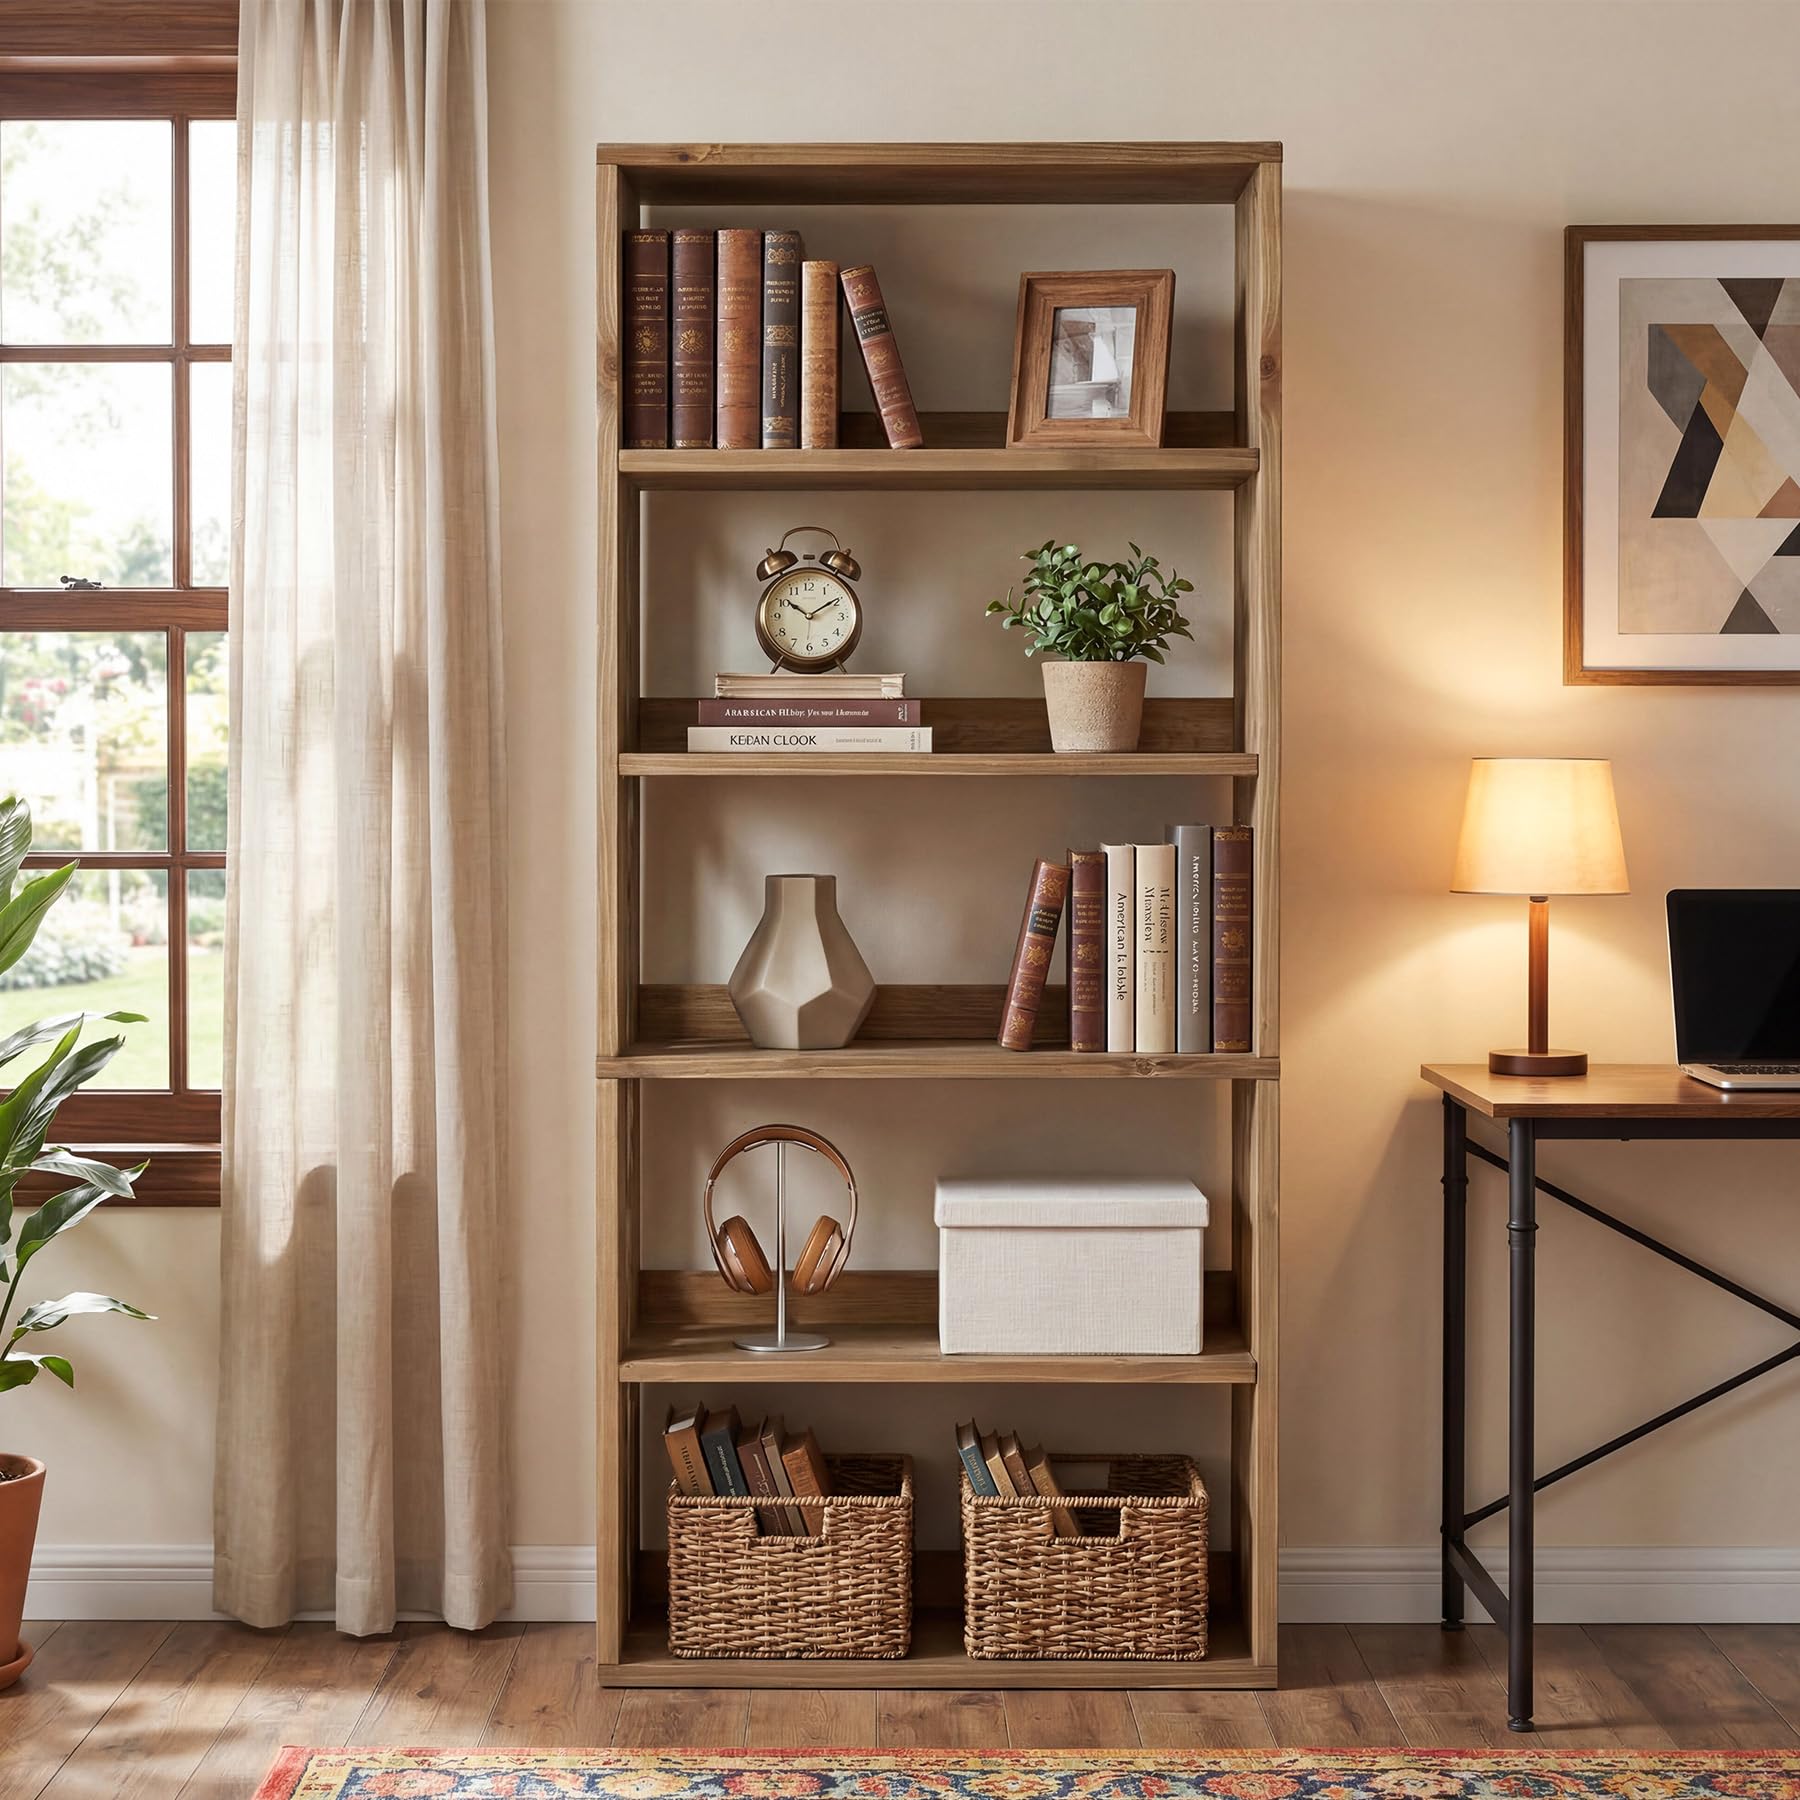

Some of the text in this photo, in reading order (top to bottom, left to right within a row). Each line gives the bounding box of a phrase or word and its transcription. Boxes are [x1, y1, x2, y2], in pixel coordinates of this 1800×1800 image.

[789, 586, 800, 596] 11
[803, 582, 815, 592] 12
[778, 598, 790, 608] 10
[833, 598, 841, 607] 2
[773, 612, 781, 621] 9
[837, 612, 845, 621] 3
[778, 627, 786, 637] 8
[832, 627, 840, 637] 4
[790, 638, 798, 648] 7
[806, 642, 814, 652] 6
[821, 638, 829, 647] 5
[773, 734, 817, 746] CLOOK
